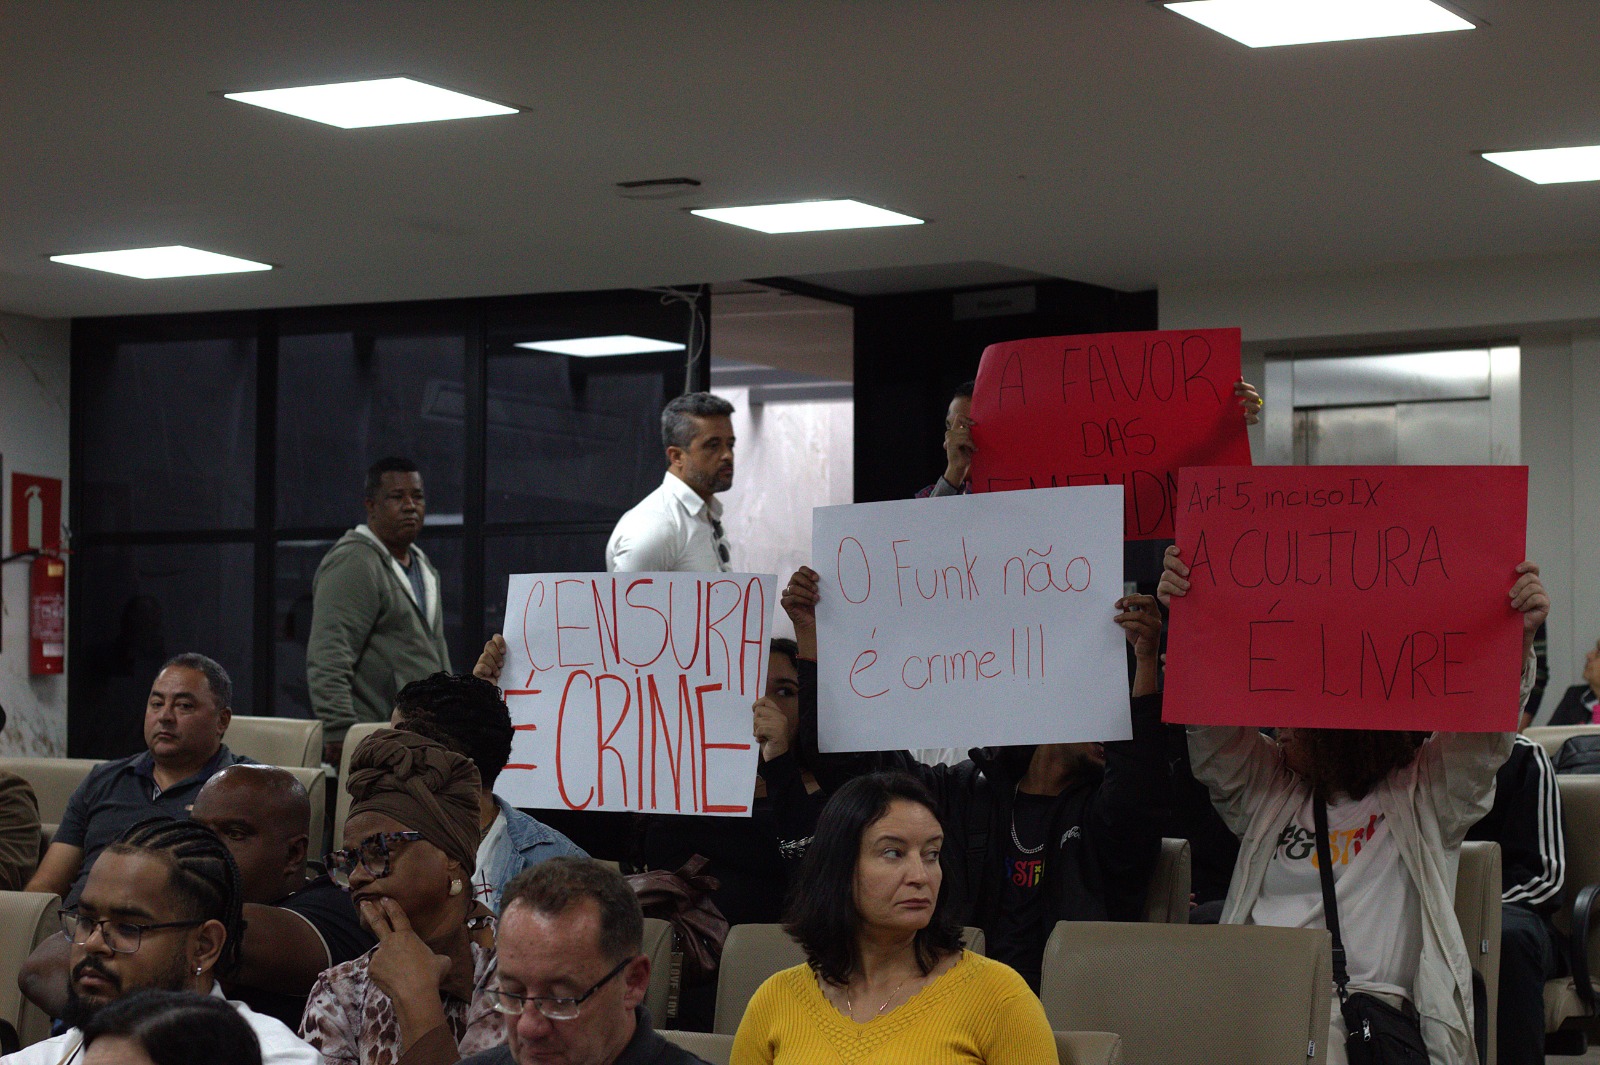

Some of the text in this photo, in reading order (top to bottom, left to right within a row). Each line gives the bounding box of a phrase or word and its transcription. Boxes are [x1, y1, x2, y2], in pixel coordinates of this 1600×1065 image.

[1000, 334, 1222, 406] A FAVOR
[1080, 416, 1157, 458] DAS
[837, 536, 1092, 608] O Funk não
[1187, 525, 1450, 591] A CULTURA
[523, 576, 765, 700] CENSURA
[849, 626, 890, 699] é
[1248, 599, 1475, 700] É LIVRE
